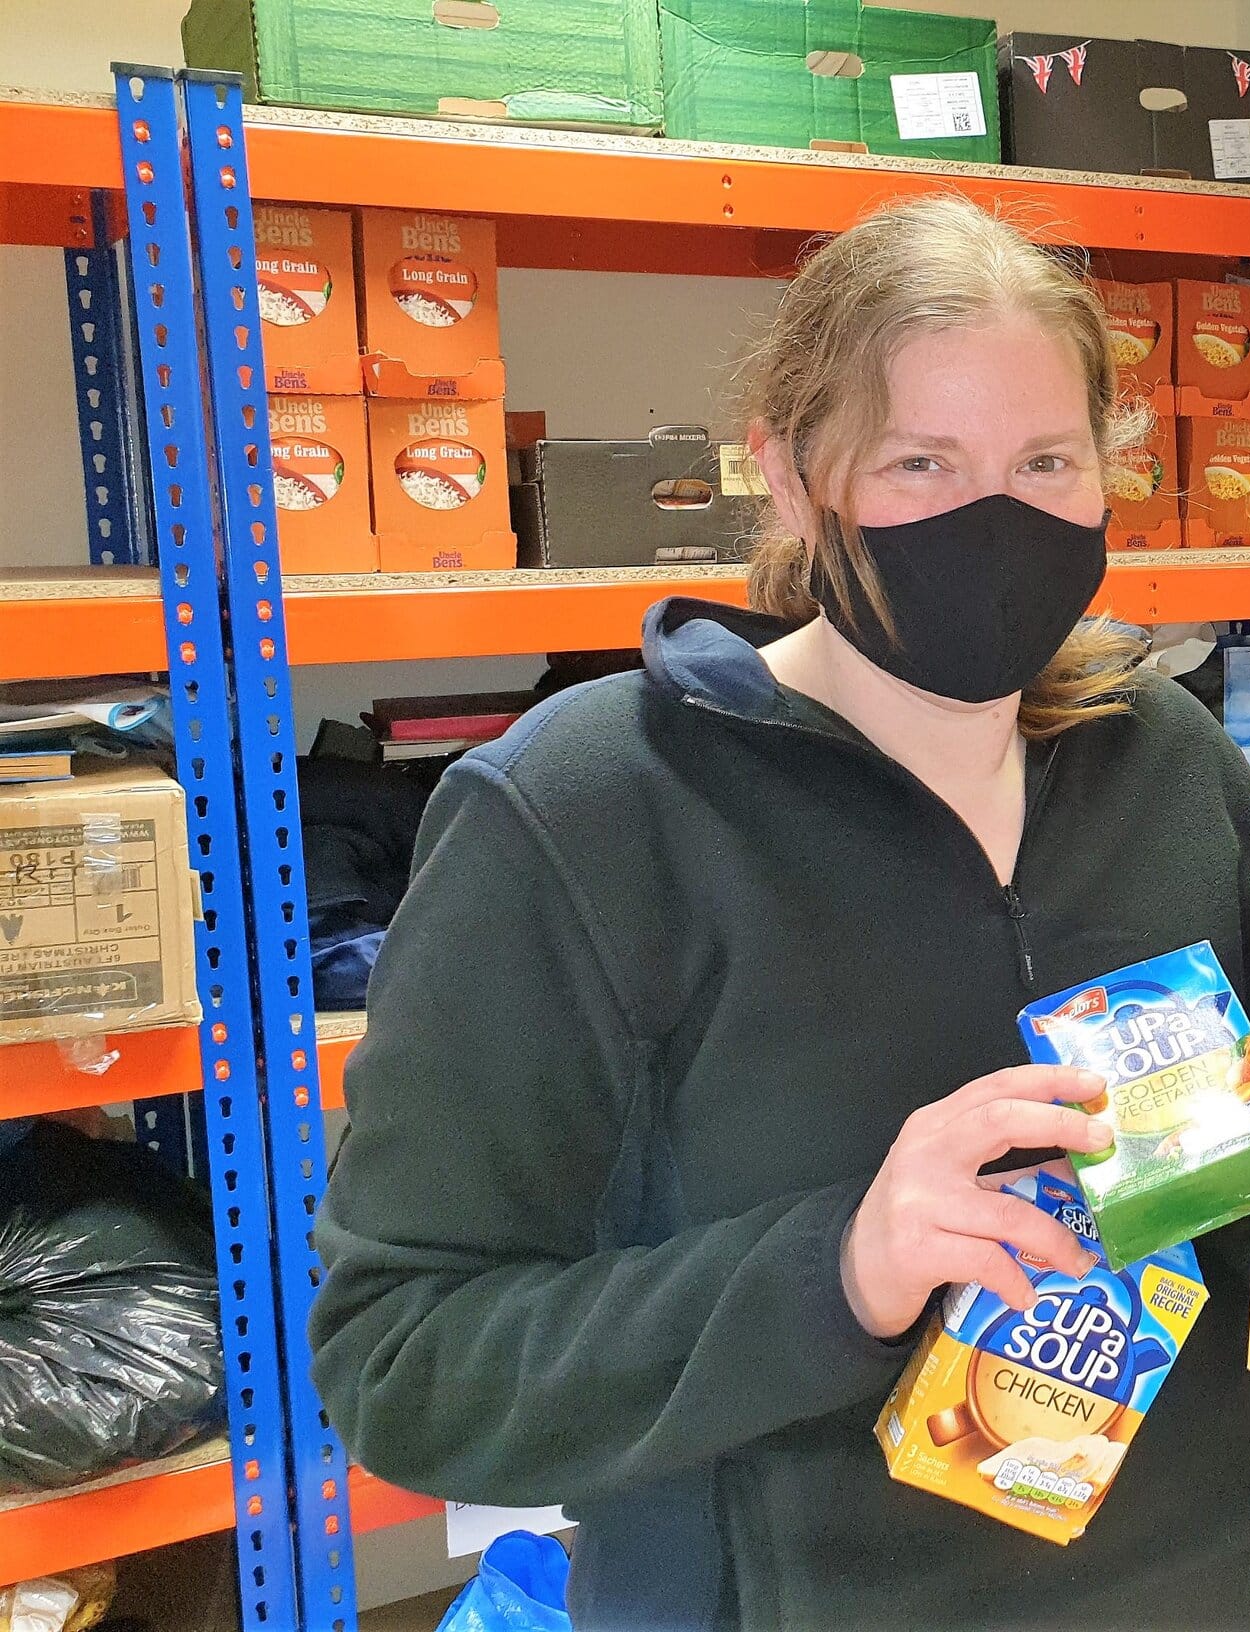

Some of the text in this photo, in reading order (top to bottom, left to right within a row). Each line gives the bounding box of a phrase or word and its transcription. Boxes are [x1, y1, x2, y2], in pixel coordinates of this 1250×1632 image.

[256, 259, 318, 274] ong Grain
[403, 268, 469, 285] Long Grain
[274, 398, 324, 415] Uncle
[420, 402, 466, 419] Uncle
[293, 445, 330, 459] Grain
[406, 446, 473, 460] Long Grain
[33, 943, 119, 960] CHRISTMAS
[17, 957, 98, 973] AUSTRIAN
[1114, 1059, 1209, 1106] GOLDEN
[1155, 1283, 1195, 1308] ORIGINAL
[1159, 1277, 1176, 1288] BACK
[1186, 1287, 1200, 1299] OUR
[1150, 1292, 1192, 1319] RECIPE
[1003, 1323, 1119, 1389] SOUP
[993, 1368, 1097, 1422] CHICKEN
[907, 1444, 950, 1470] 3 Sachets
